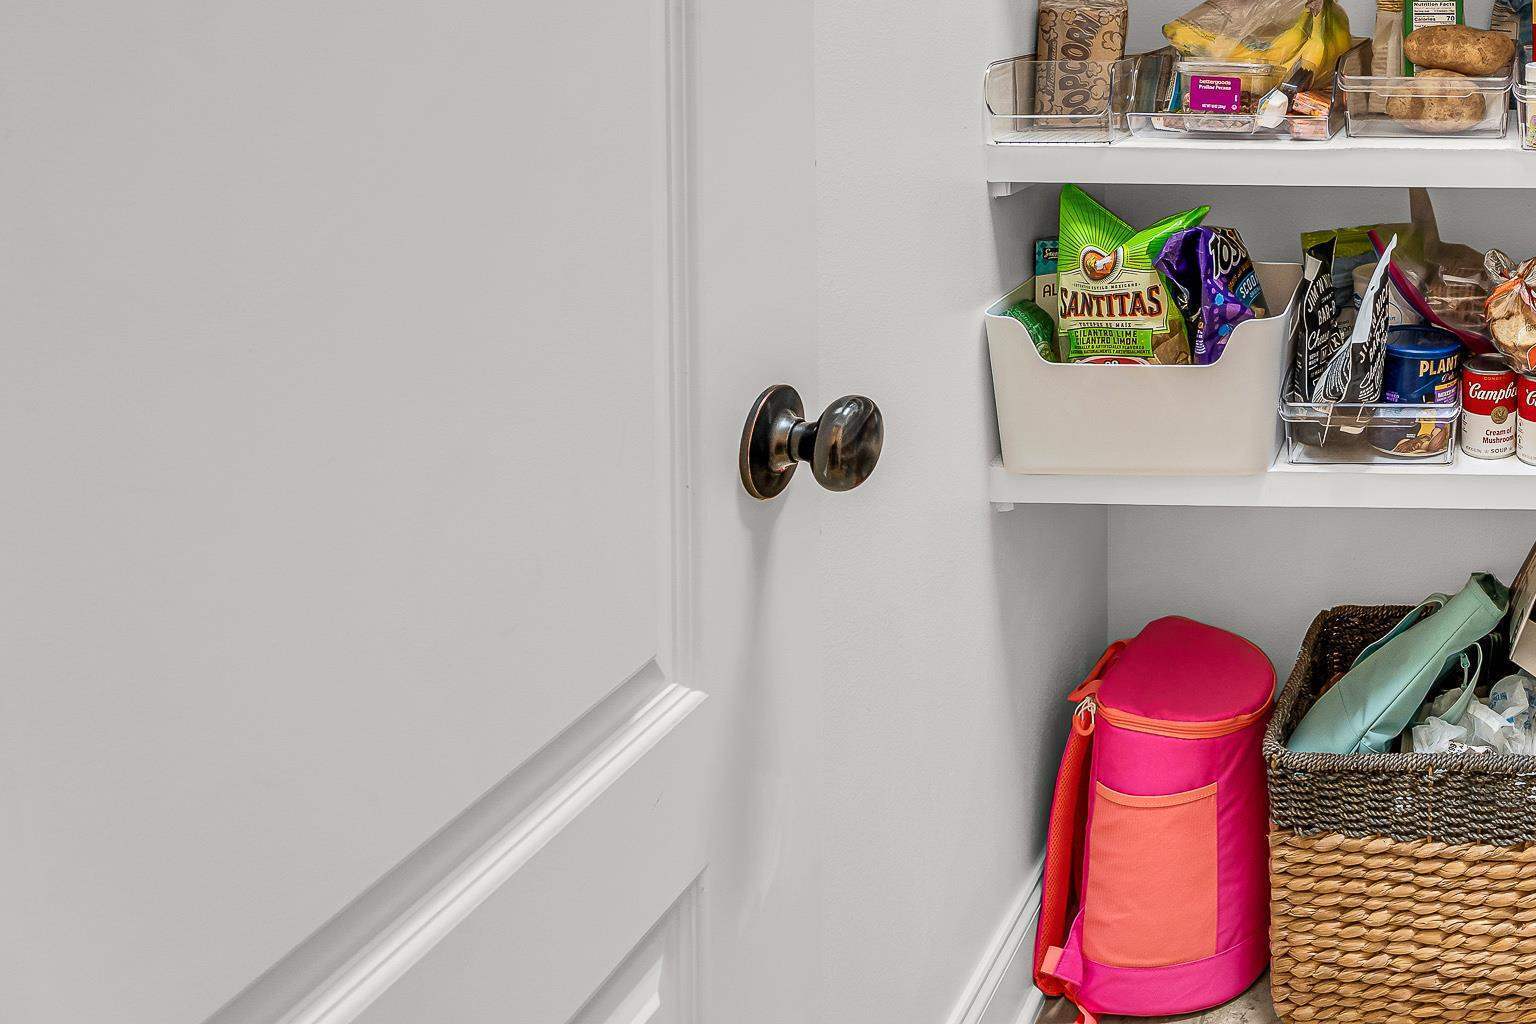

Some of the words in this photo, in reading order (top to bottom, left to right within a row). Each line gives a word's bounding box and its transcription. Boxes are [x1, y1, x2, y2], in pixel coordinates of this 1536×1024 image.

[1060, 285, 1162, 319] SANTITAS
[1074, 329, 1113, 338] CILANTRO
[1114, 330, 1137, 338] LIME
[1076, 337, 1112, 345] CILANTRO
[1485, 428, 1505, 436] Cream
[1482, 435, 1514, 444] Mushroom
